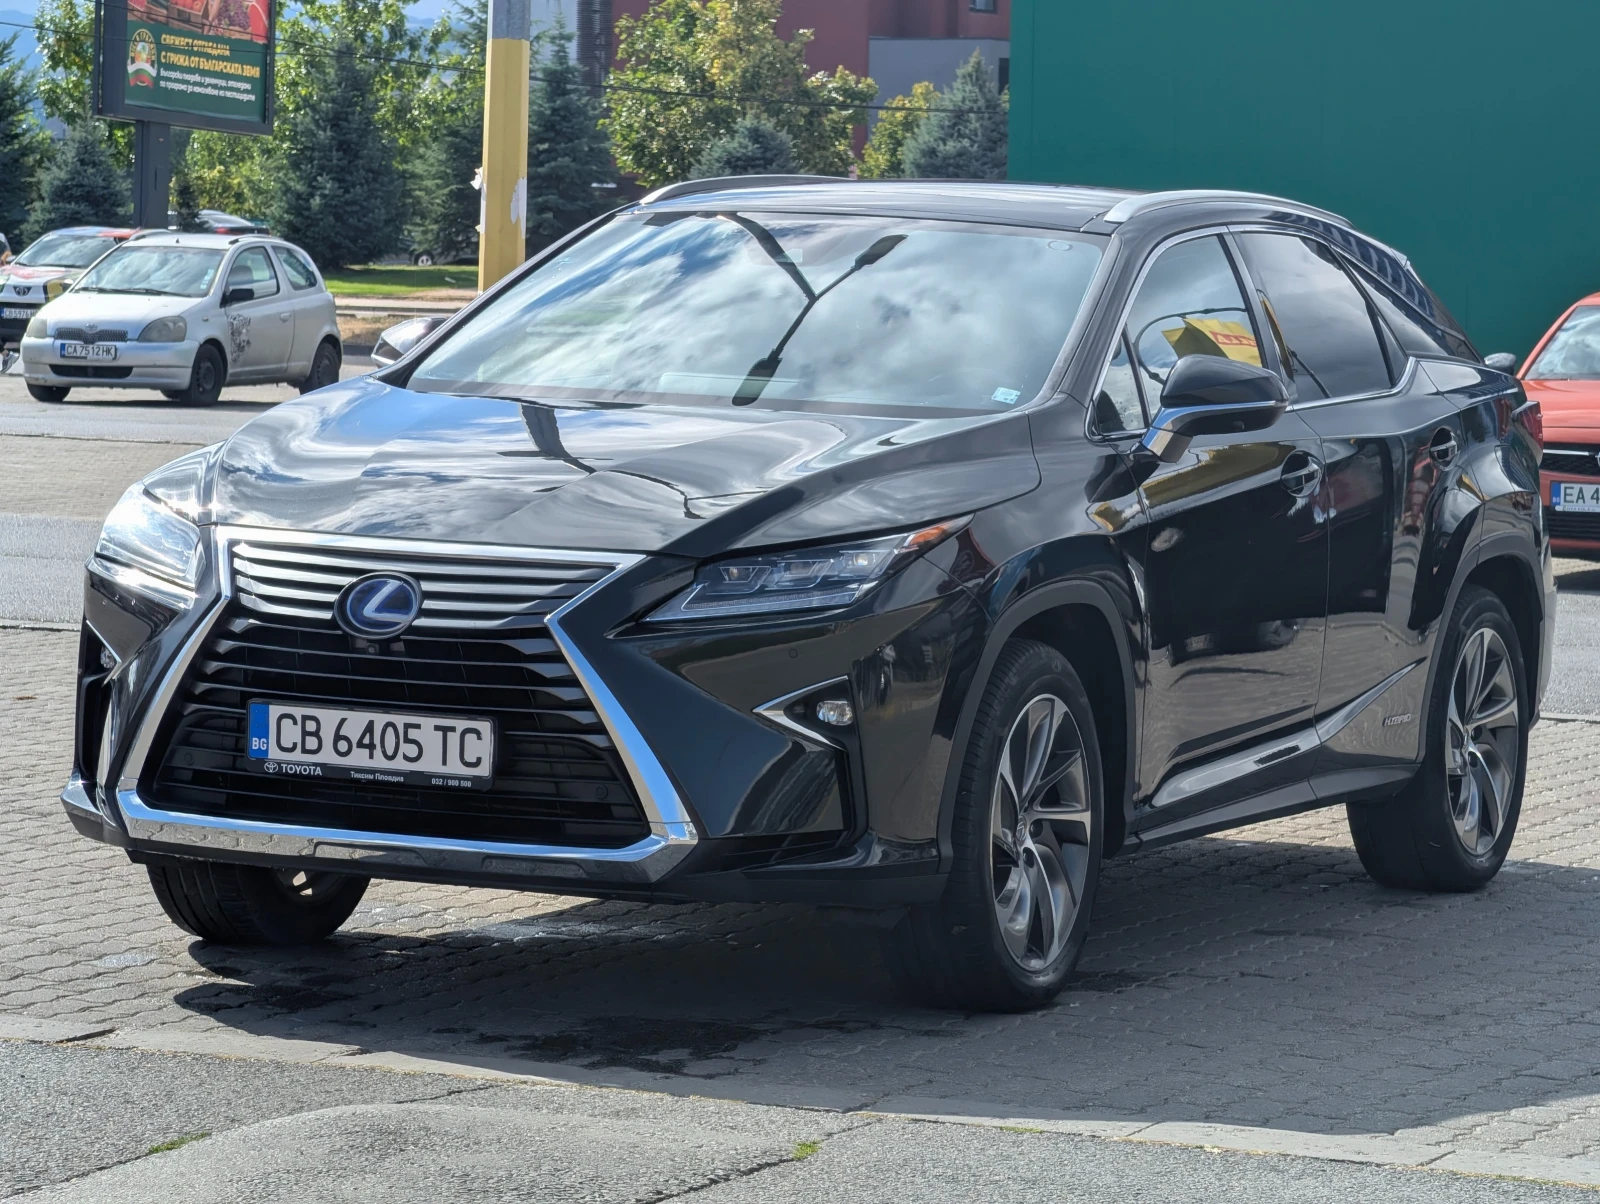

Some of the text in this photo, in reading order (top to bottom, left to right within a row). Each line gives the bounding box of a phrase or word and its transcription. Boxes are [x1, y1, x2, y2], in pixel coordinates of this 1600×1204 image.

[166, 52, 190, 67] ГРИЖА
[190, 56, 199, 68] ОТ
[199, 57, 243, 75] БЪЛГАРСКАТА
[243, 64, 260, 78] ЗЕМЯ
[66, 346, 114, 358] CA 7512 HK
[1563, 486, 1586, 504] EA
[251, 737, 267, 750] BG
[275, 712, 483, 769] CB 6405 TC
[281, 763, 322, 776] TOYOTA
[375, 773, 404, 783] Пловдив
[431, 777, 443, 787] 032
